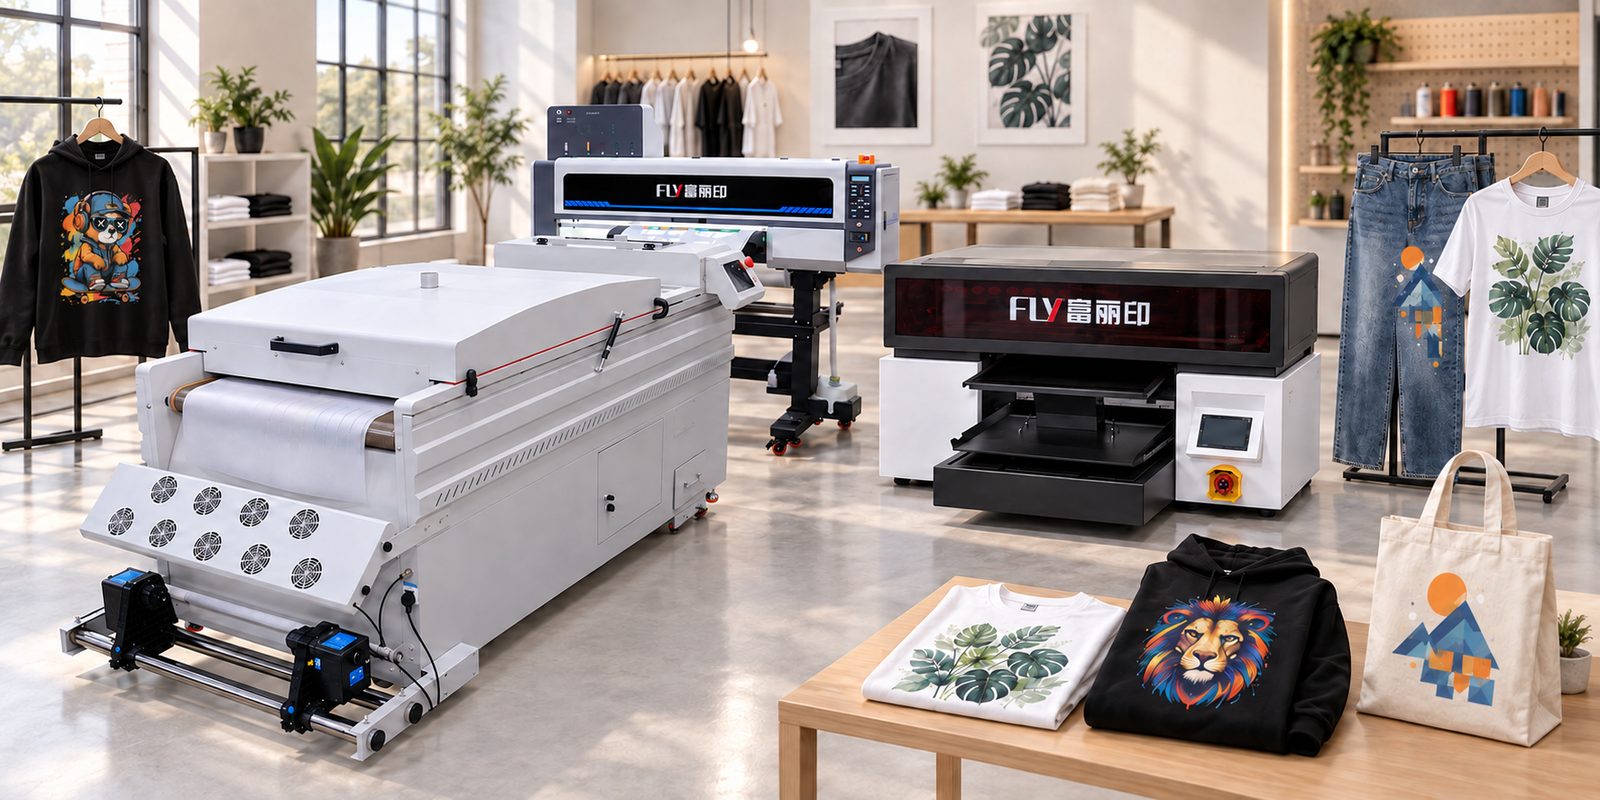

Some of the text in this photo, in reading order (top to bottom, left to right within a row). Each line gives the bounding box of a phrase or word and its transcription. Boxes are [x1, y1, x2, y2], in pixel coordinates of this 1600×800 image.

[656, 183, 683, 198] FLY
[1009, 296, 1151, 326] FLY 富丽印
